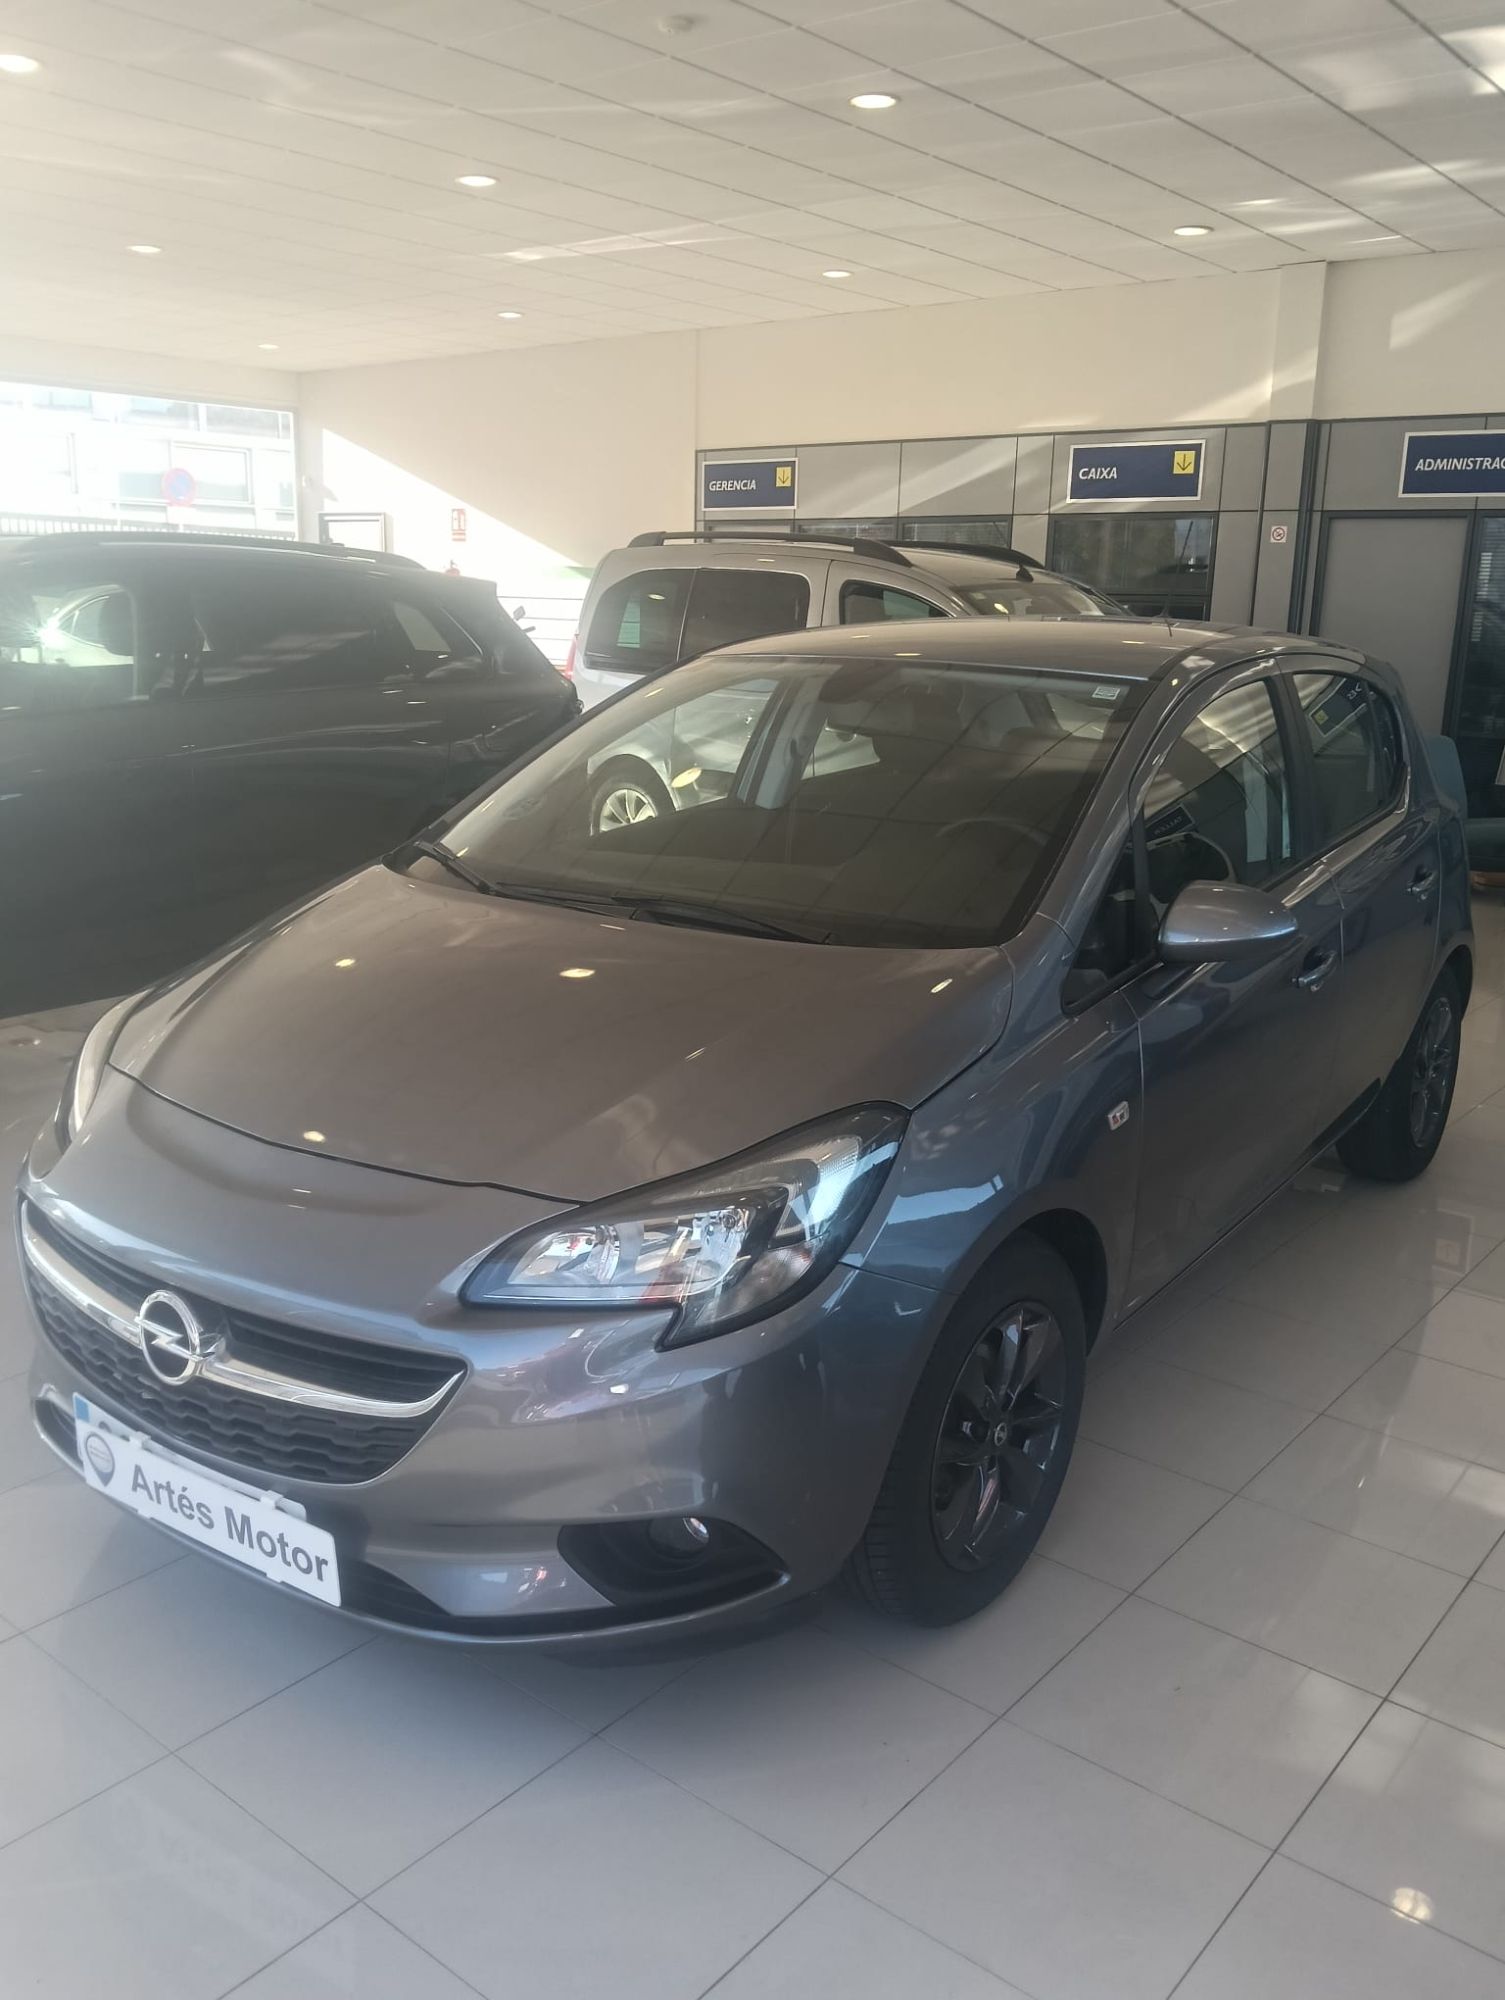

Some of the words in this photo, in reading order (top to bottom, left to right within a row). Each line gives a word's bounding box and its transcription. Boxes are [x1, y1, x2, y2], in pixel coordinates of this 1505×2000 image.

[1079, 466, 1118, 480] CAIXA
[708, 479, 757, 492] GERENCIA
[131, 1464, 215, 1530] Artés
[224, 1506, 329, 1582] Motor
